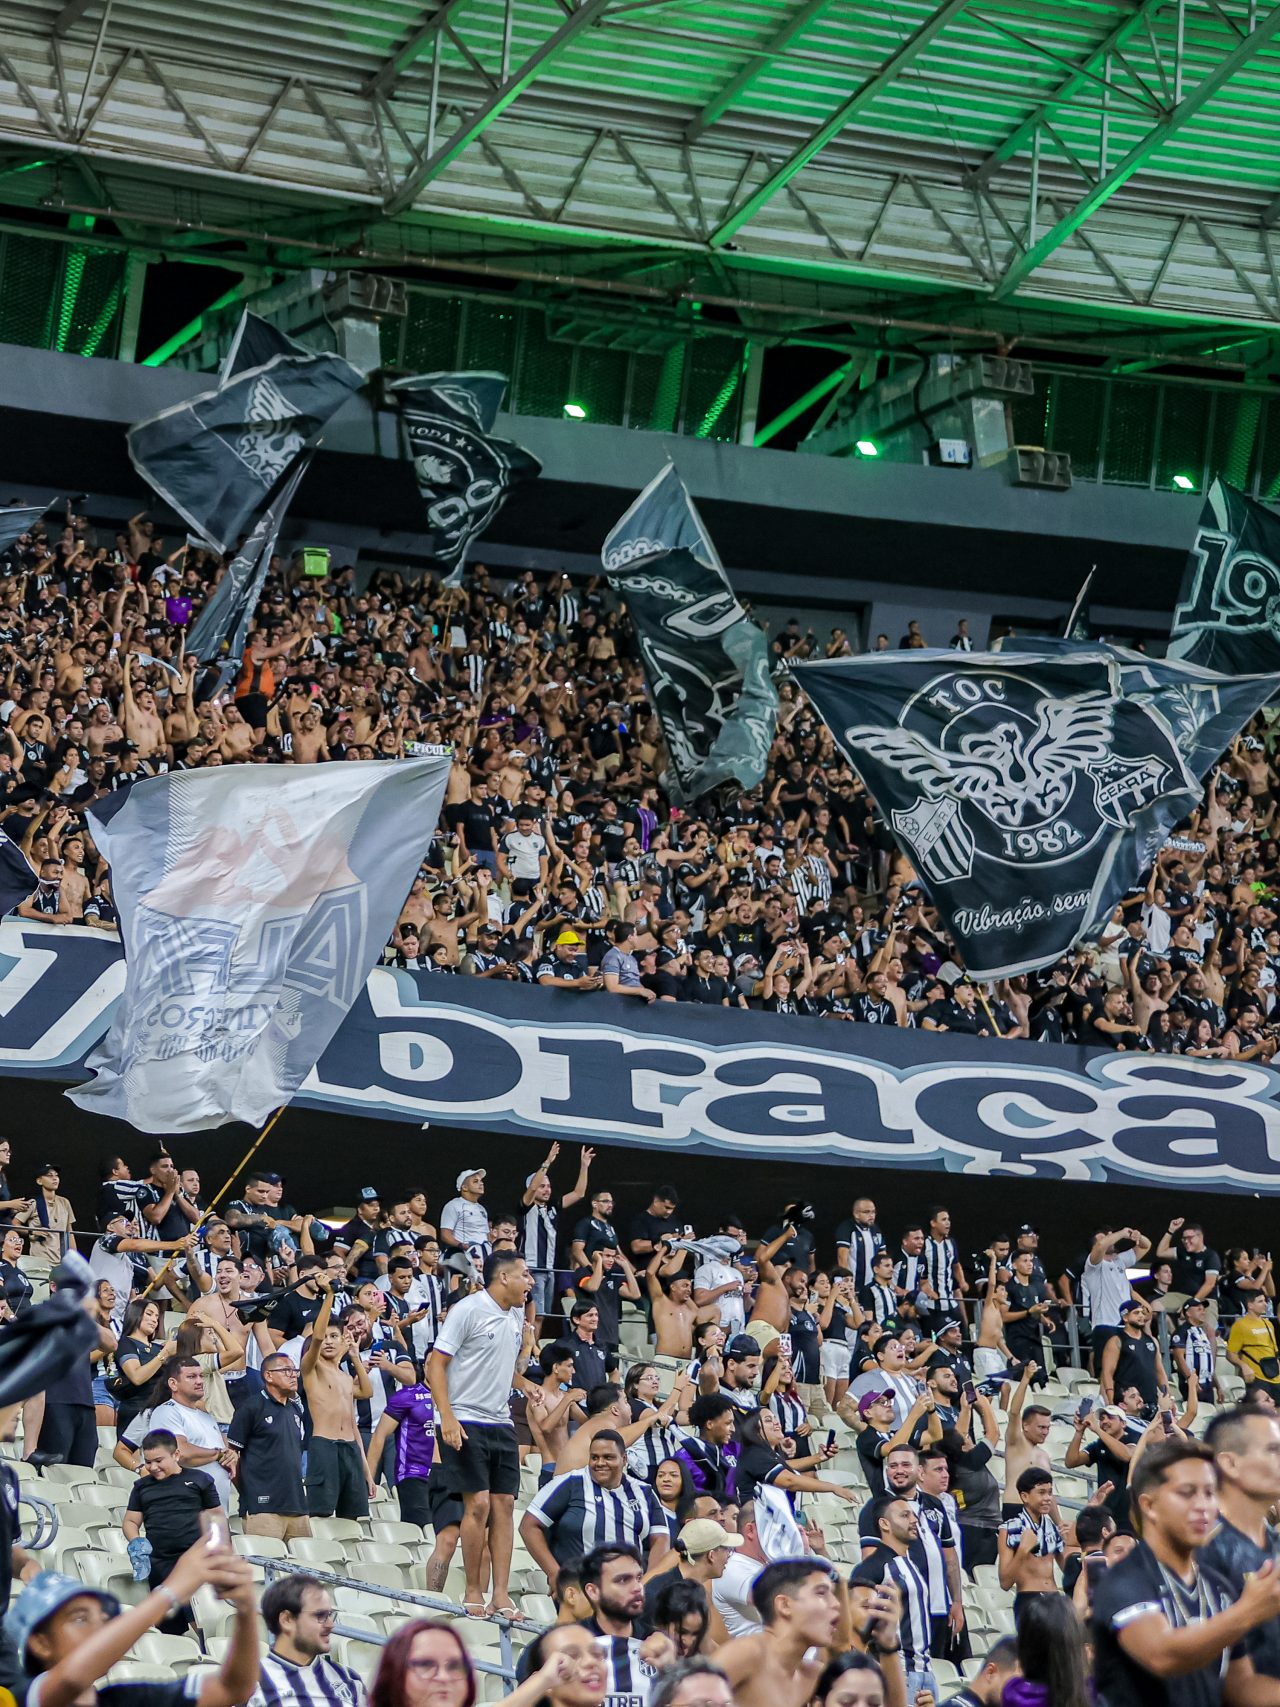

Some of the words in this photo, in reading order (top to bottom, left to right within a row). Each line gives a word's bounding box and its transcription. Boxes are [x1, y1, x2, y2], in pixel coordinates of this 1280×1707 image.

[930, 679, 1006, 715] TOC
[1002, 820, 1084, 858] 1982
[1053, 891, 1091, 915] sem
